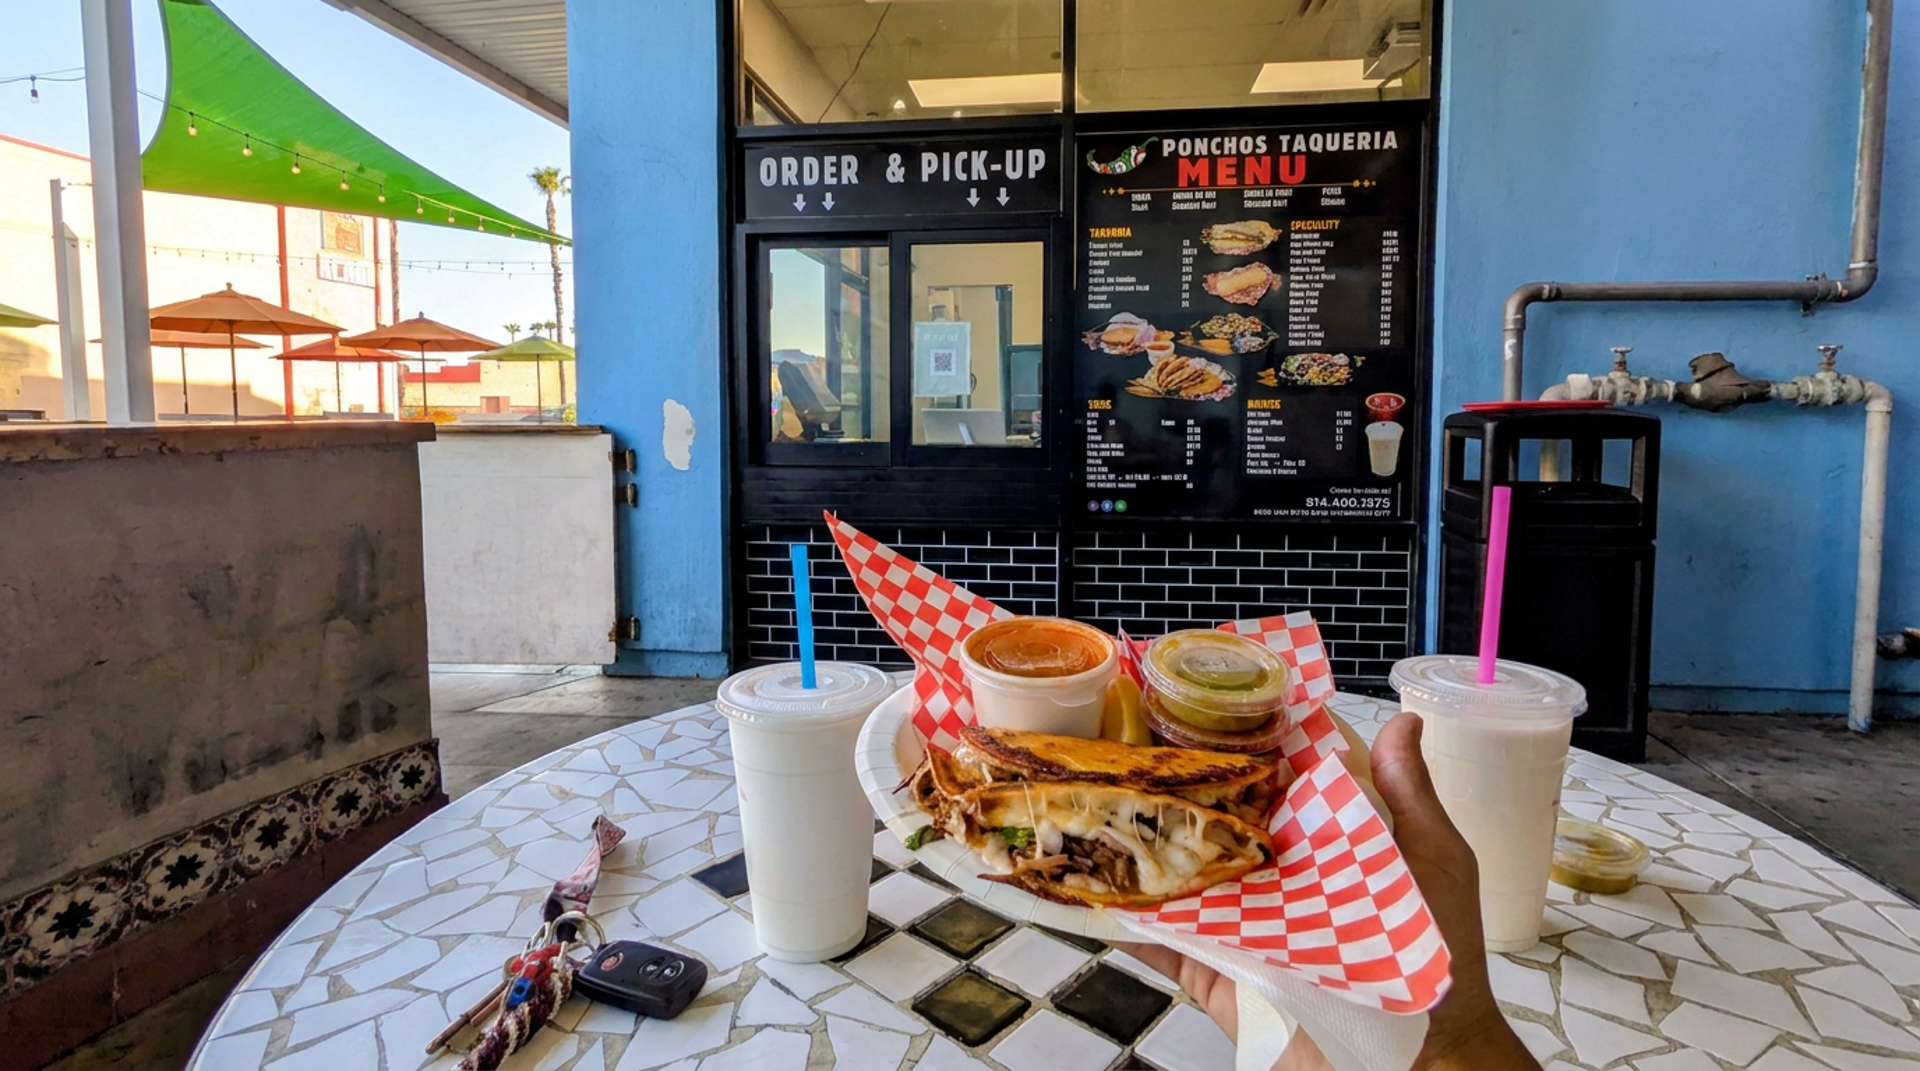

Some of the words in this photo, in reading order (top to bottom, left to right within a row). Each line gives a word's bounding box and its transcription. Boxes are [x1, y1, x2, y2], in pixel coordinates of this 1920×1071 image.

[1162, 134, 1268, 157] PONCHOS
[1279, 130, 1398, 153] TAQUERIA
[759, 154, 859, 187] ORDER
[885, 152, 905, 184] &
[921, 148, 1046, 183] PICK-UP
[1178, 155, 1307, 187] MENU
